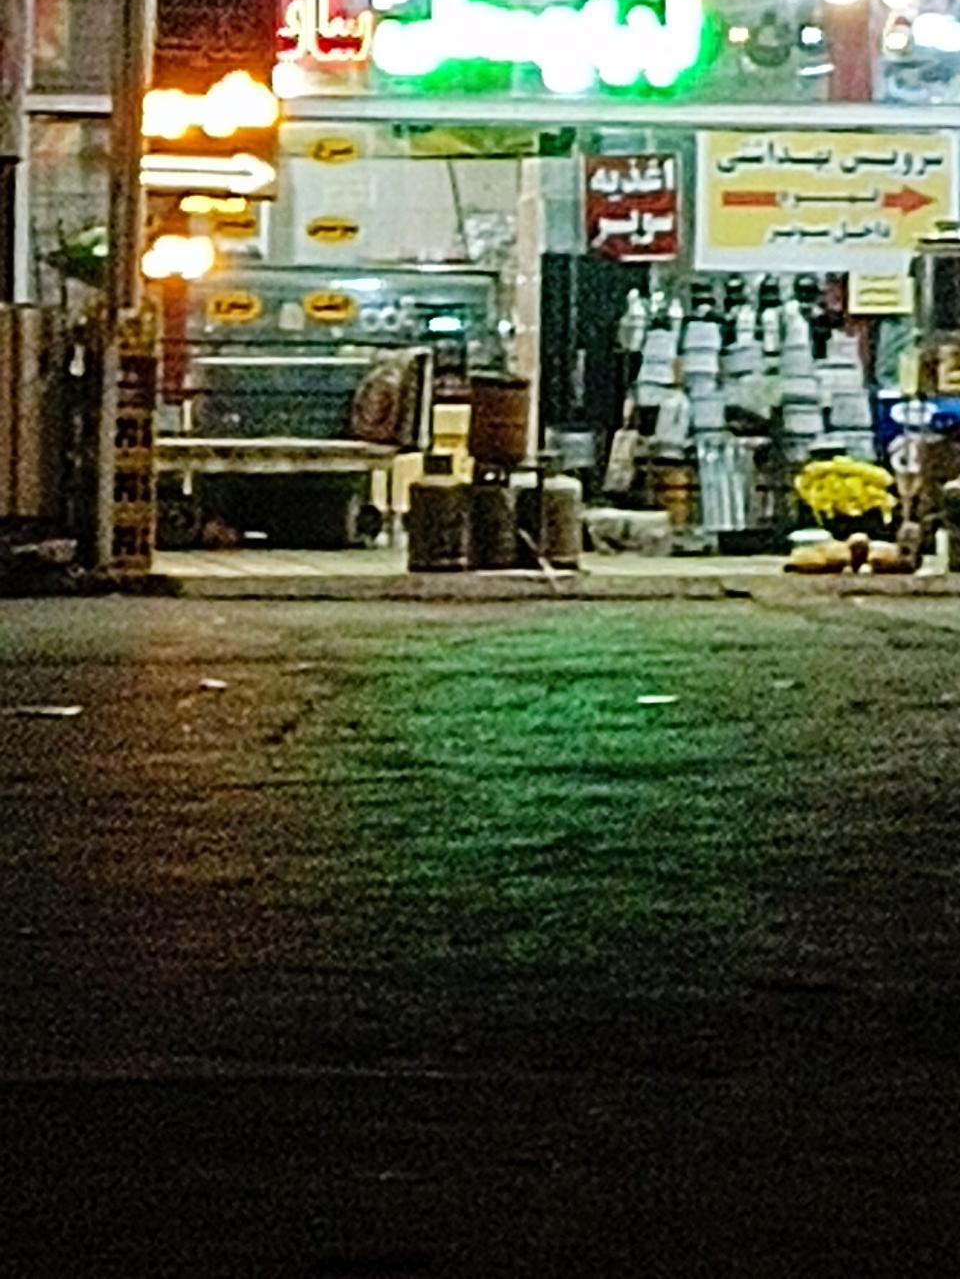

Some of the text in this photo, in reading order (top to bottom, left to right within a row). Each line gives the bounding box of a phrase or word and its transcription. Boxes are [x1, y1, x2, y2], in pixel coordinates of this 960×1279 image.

[717, 140, 943, 176] سرویس بهداشتی
[591, 158, 674, 202] اغذیه
